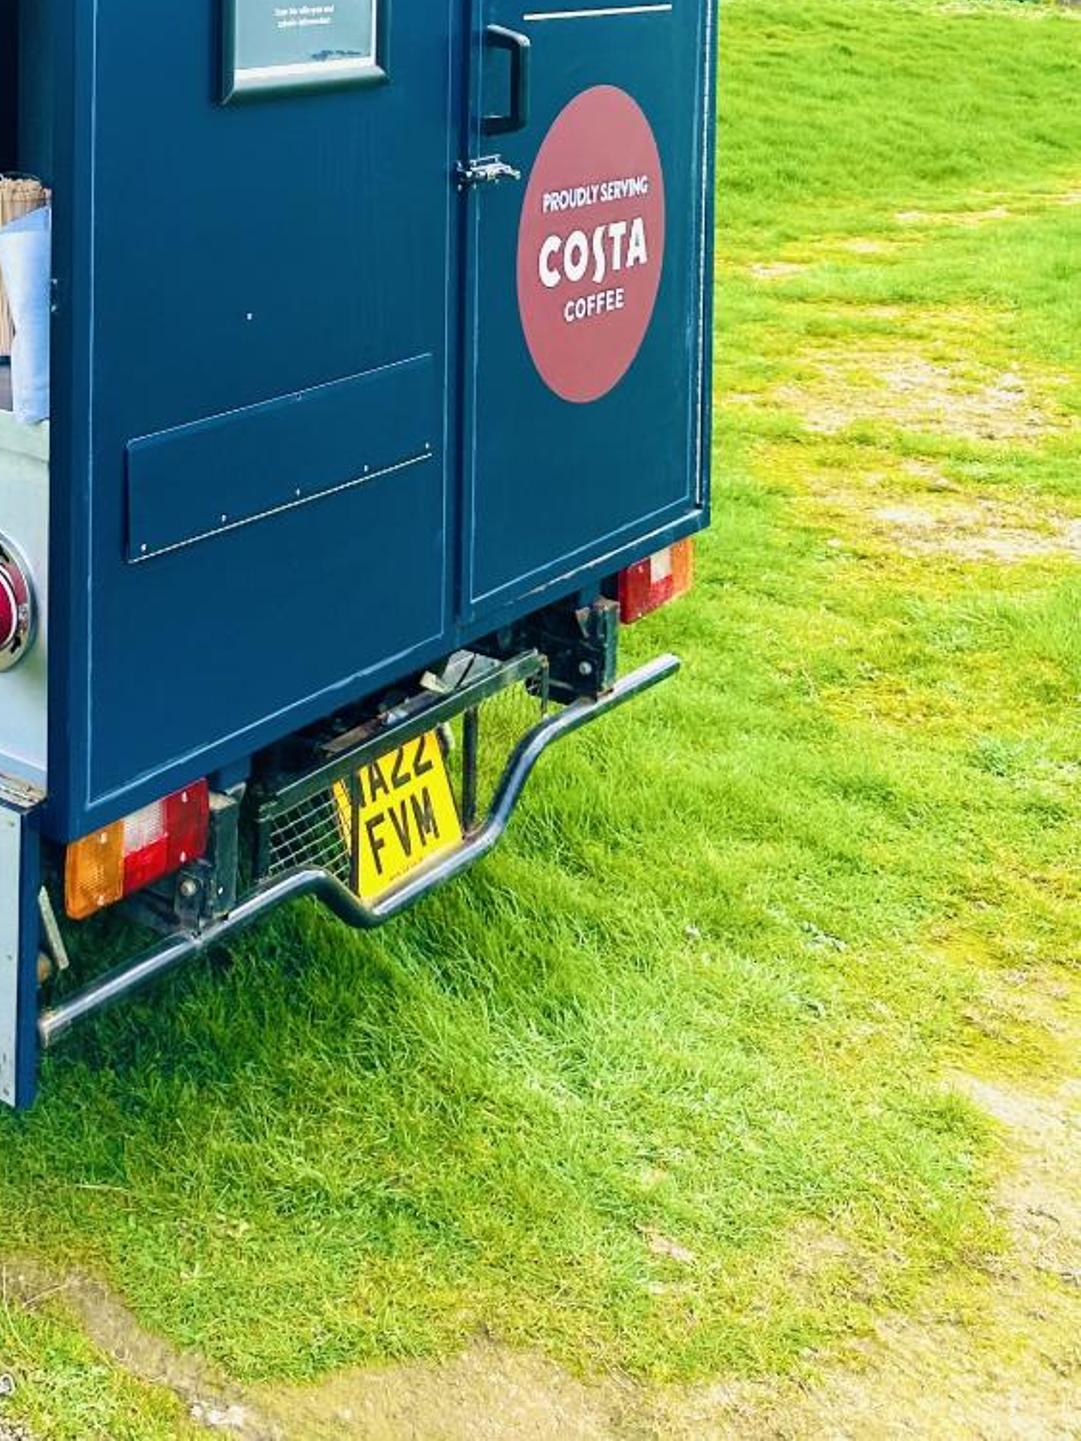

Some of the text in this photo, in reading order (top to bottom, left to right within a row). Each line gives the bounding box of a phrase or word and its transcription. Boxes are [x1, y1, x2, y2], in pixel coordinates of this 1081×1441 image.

[542, 175, 649, 213] PROUDLY SERVING
[538, 216, 648, 288] COSTA
[564, 288, 625, 322] COFFEE
[356, 735, 434, 809] A22
[365, 785, 441, 876] FVM
